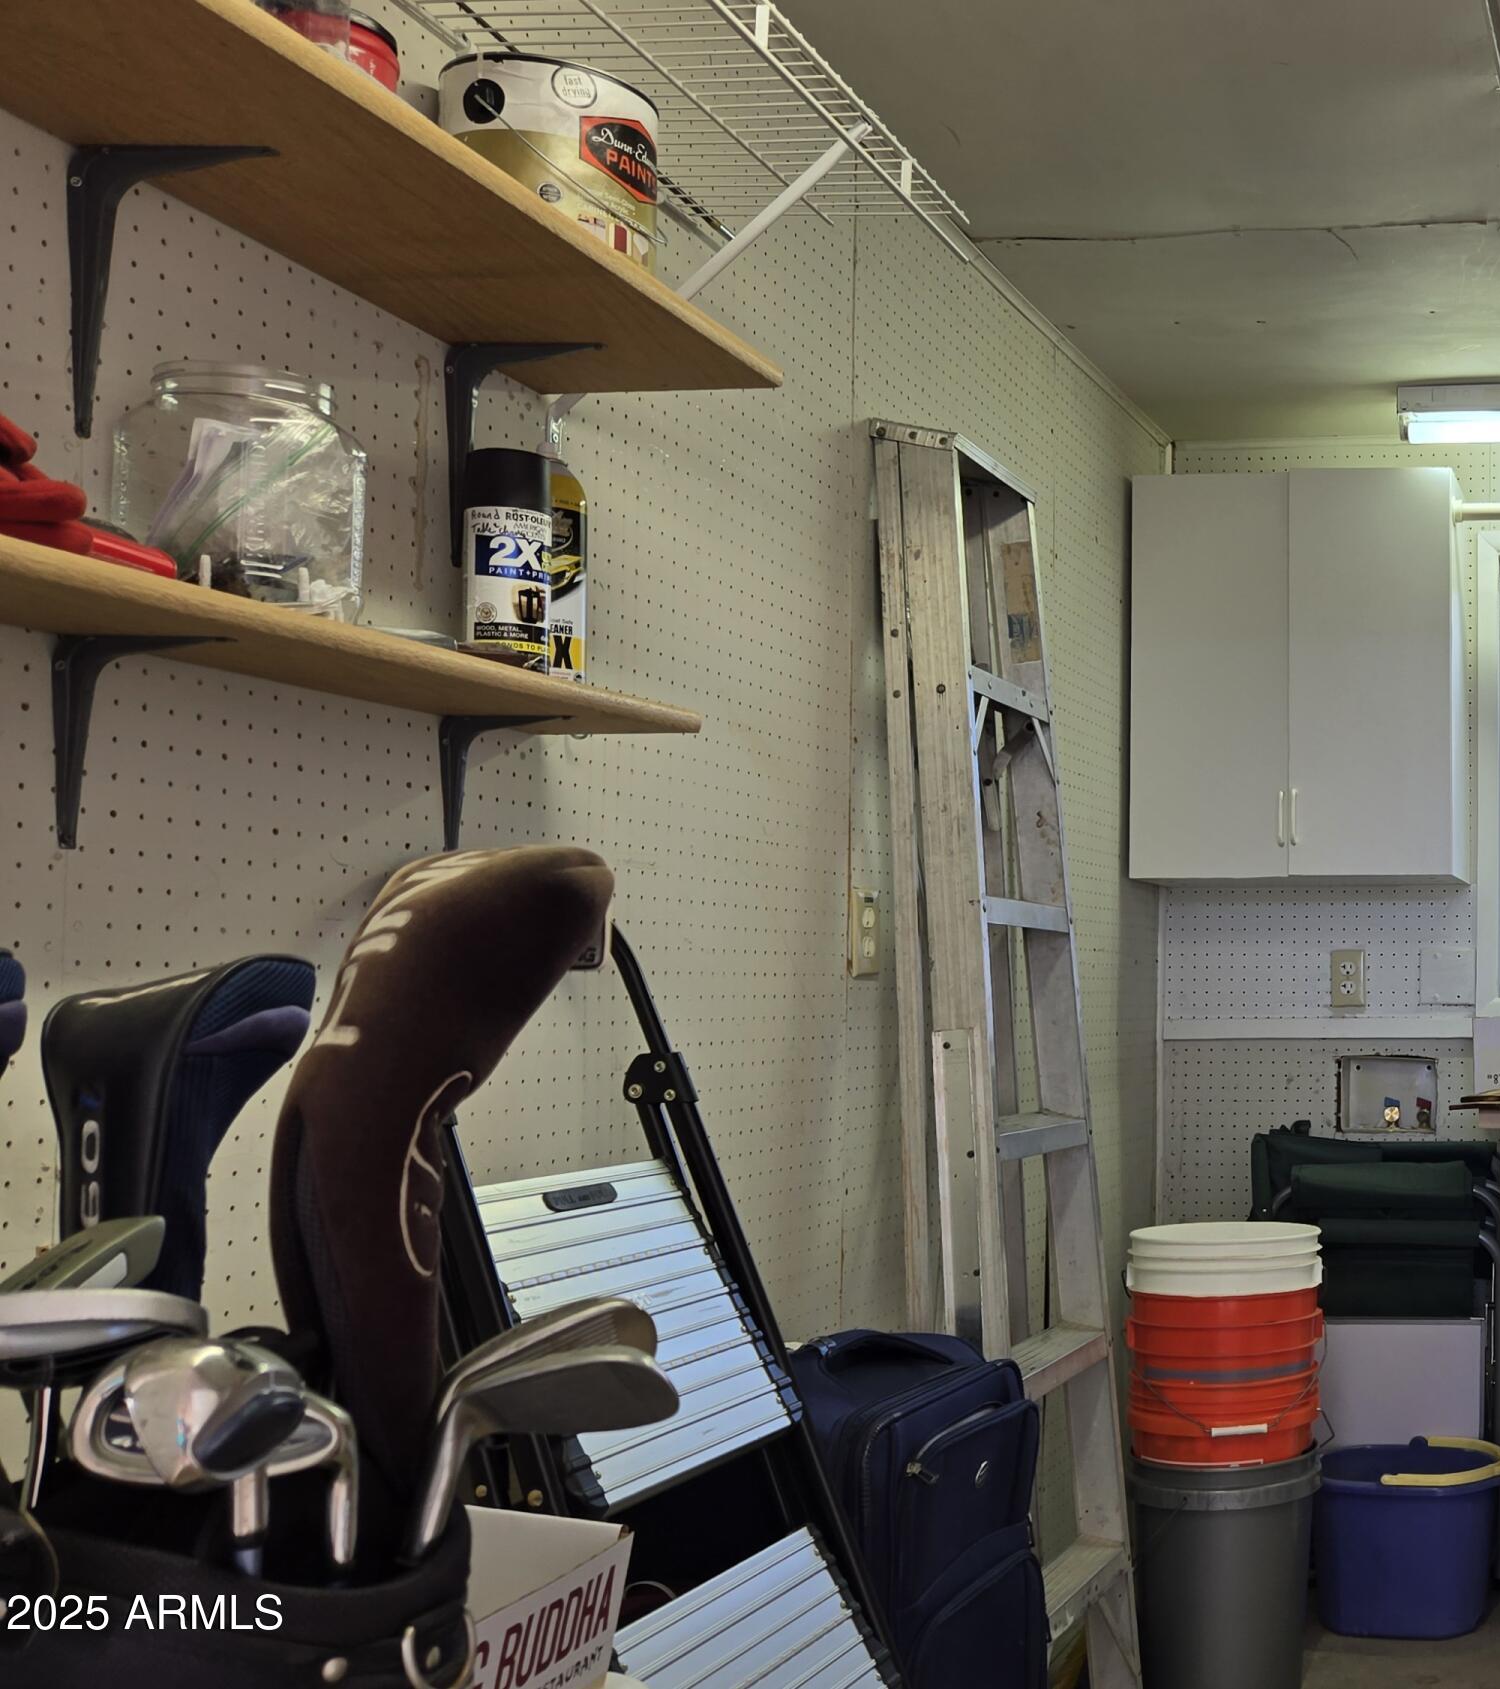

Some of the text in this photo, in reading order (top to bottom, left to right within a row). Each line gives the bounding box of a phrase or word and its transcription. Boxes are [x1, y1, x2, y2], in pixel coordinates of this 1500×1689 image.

[488, 535, 543, 571] 2X
[509, 632, 529, 640] MORE
[495, 1564, 616, 1689] BUDDHA
